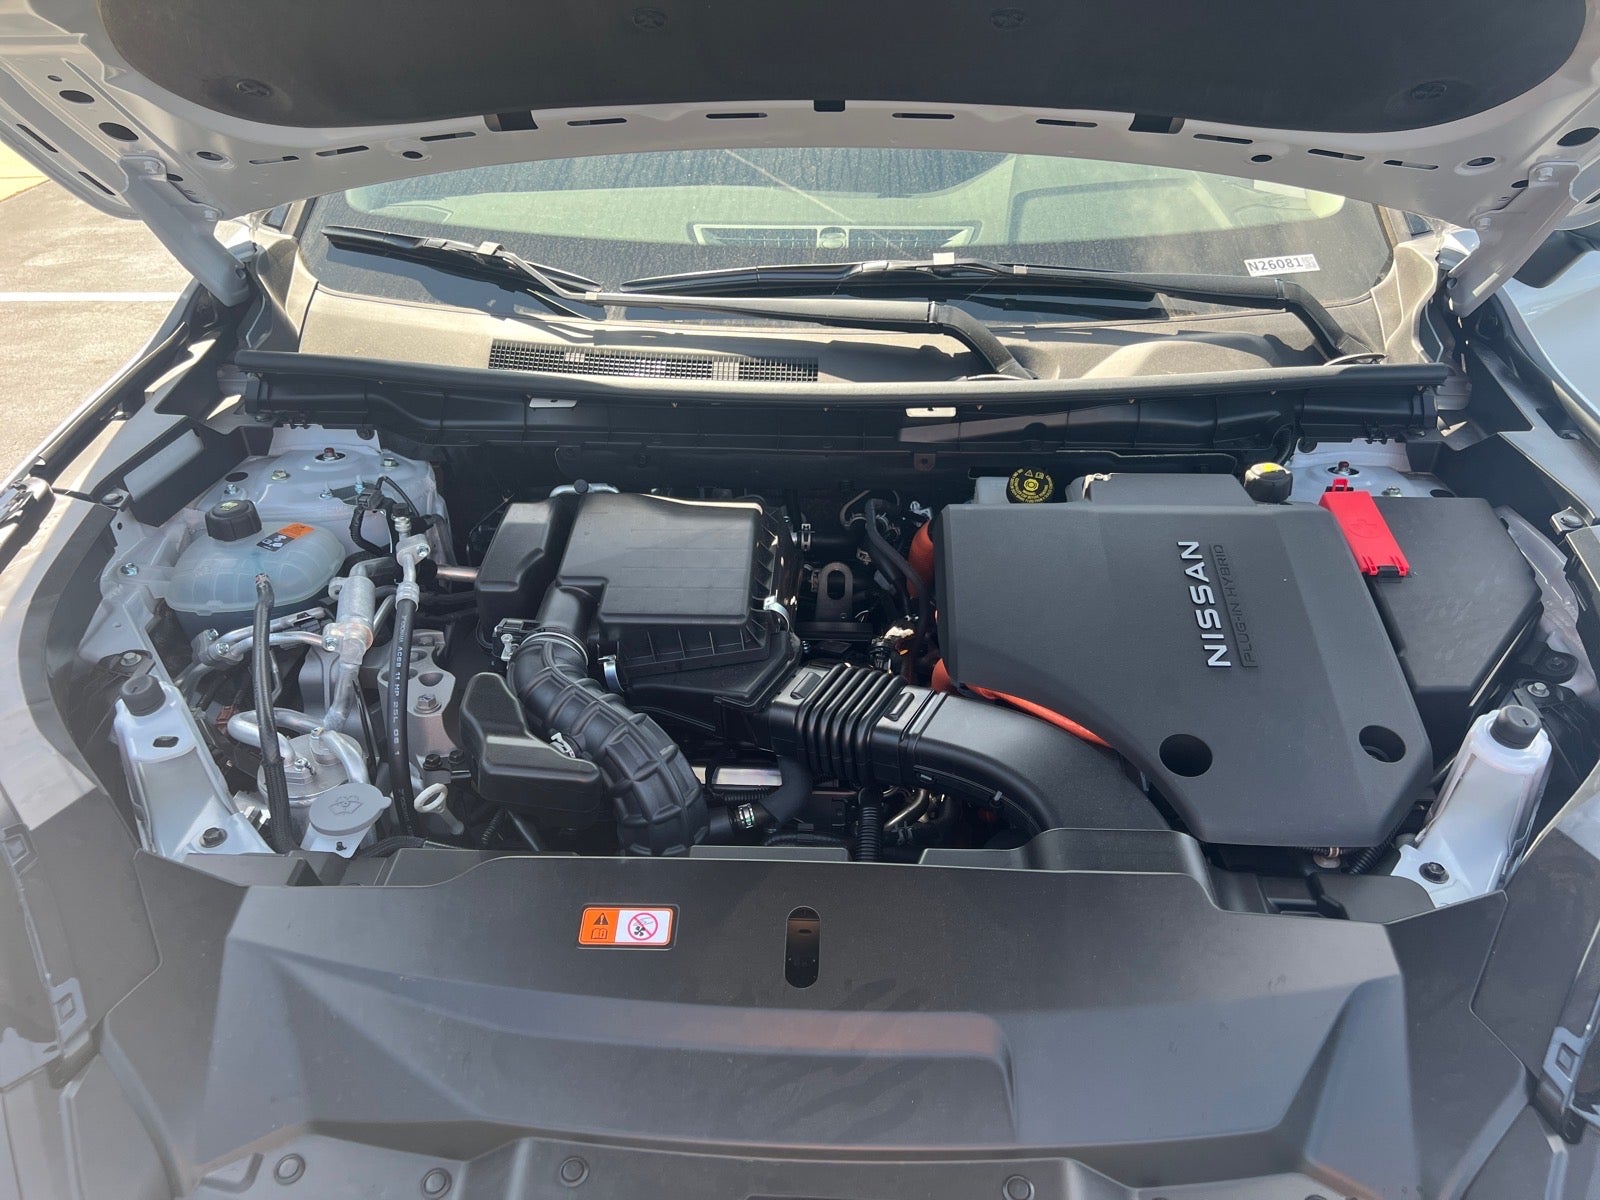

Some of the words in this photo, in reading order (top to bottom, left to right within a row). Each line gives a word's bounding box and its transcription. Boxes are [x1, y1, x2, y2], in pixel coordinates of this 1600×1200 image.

[1247, 257, 1304, 271] N26081
[1213, 544, 1237, 598] HYBRID
[1177, 541, 1232, 667] NISSAN
[1229, 602, 1257, 664] PLUG-IN
